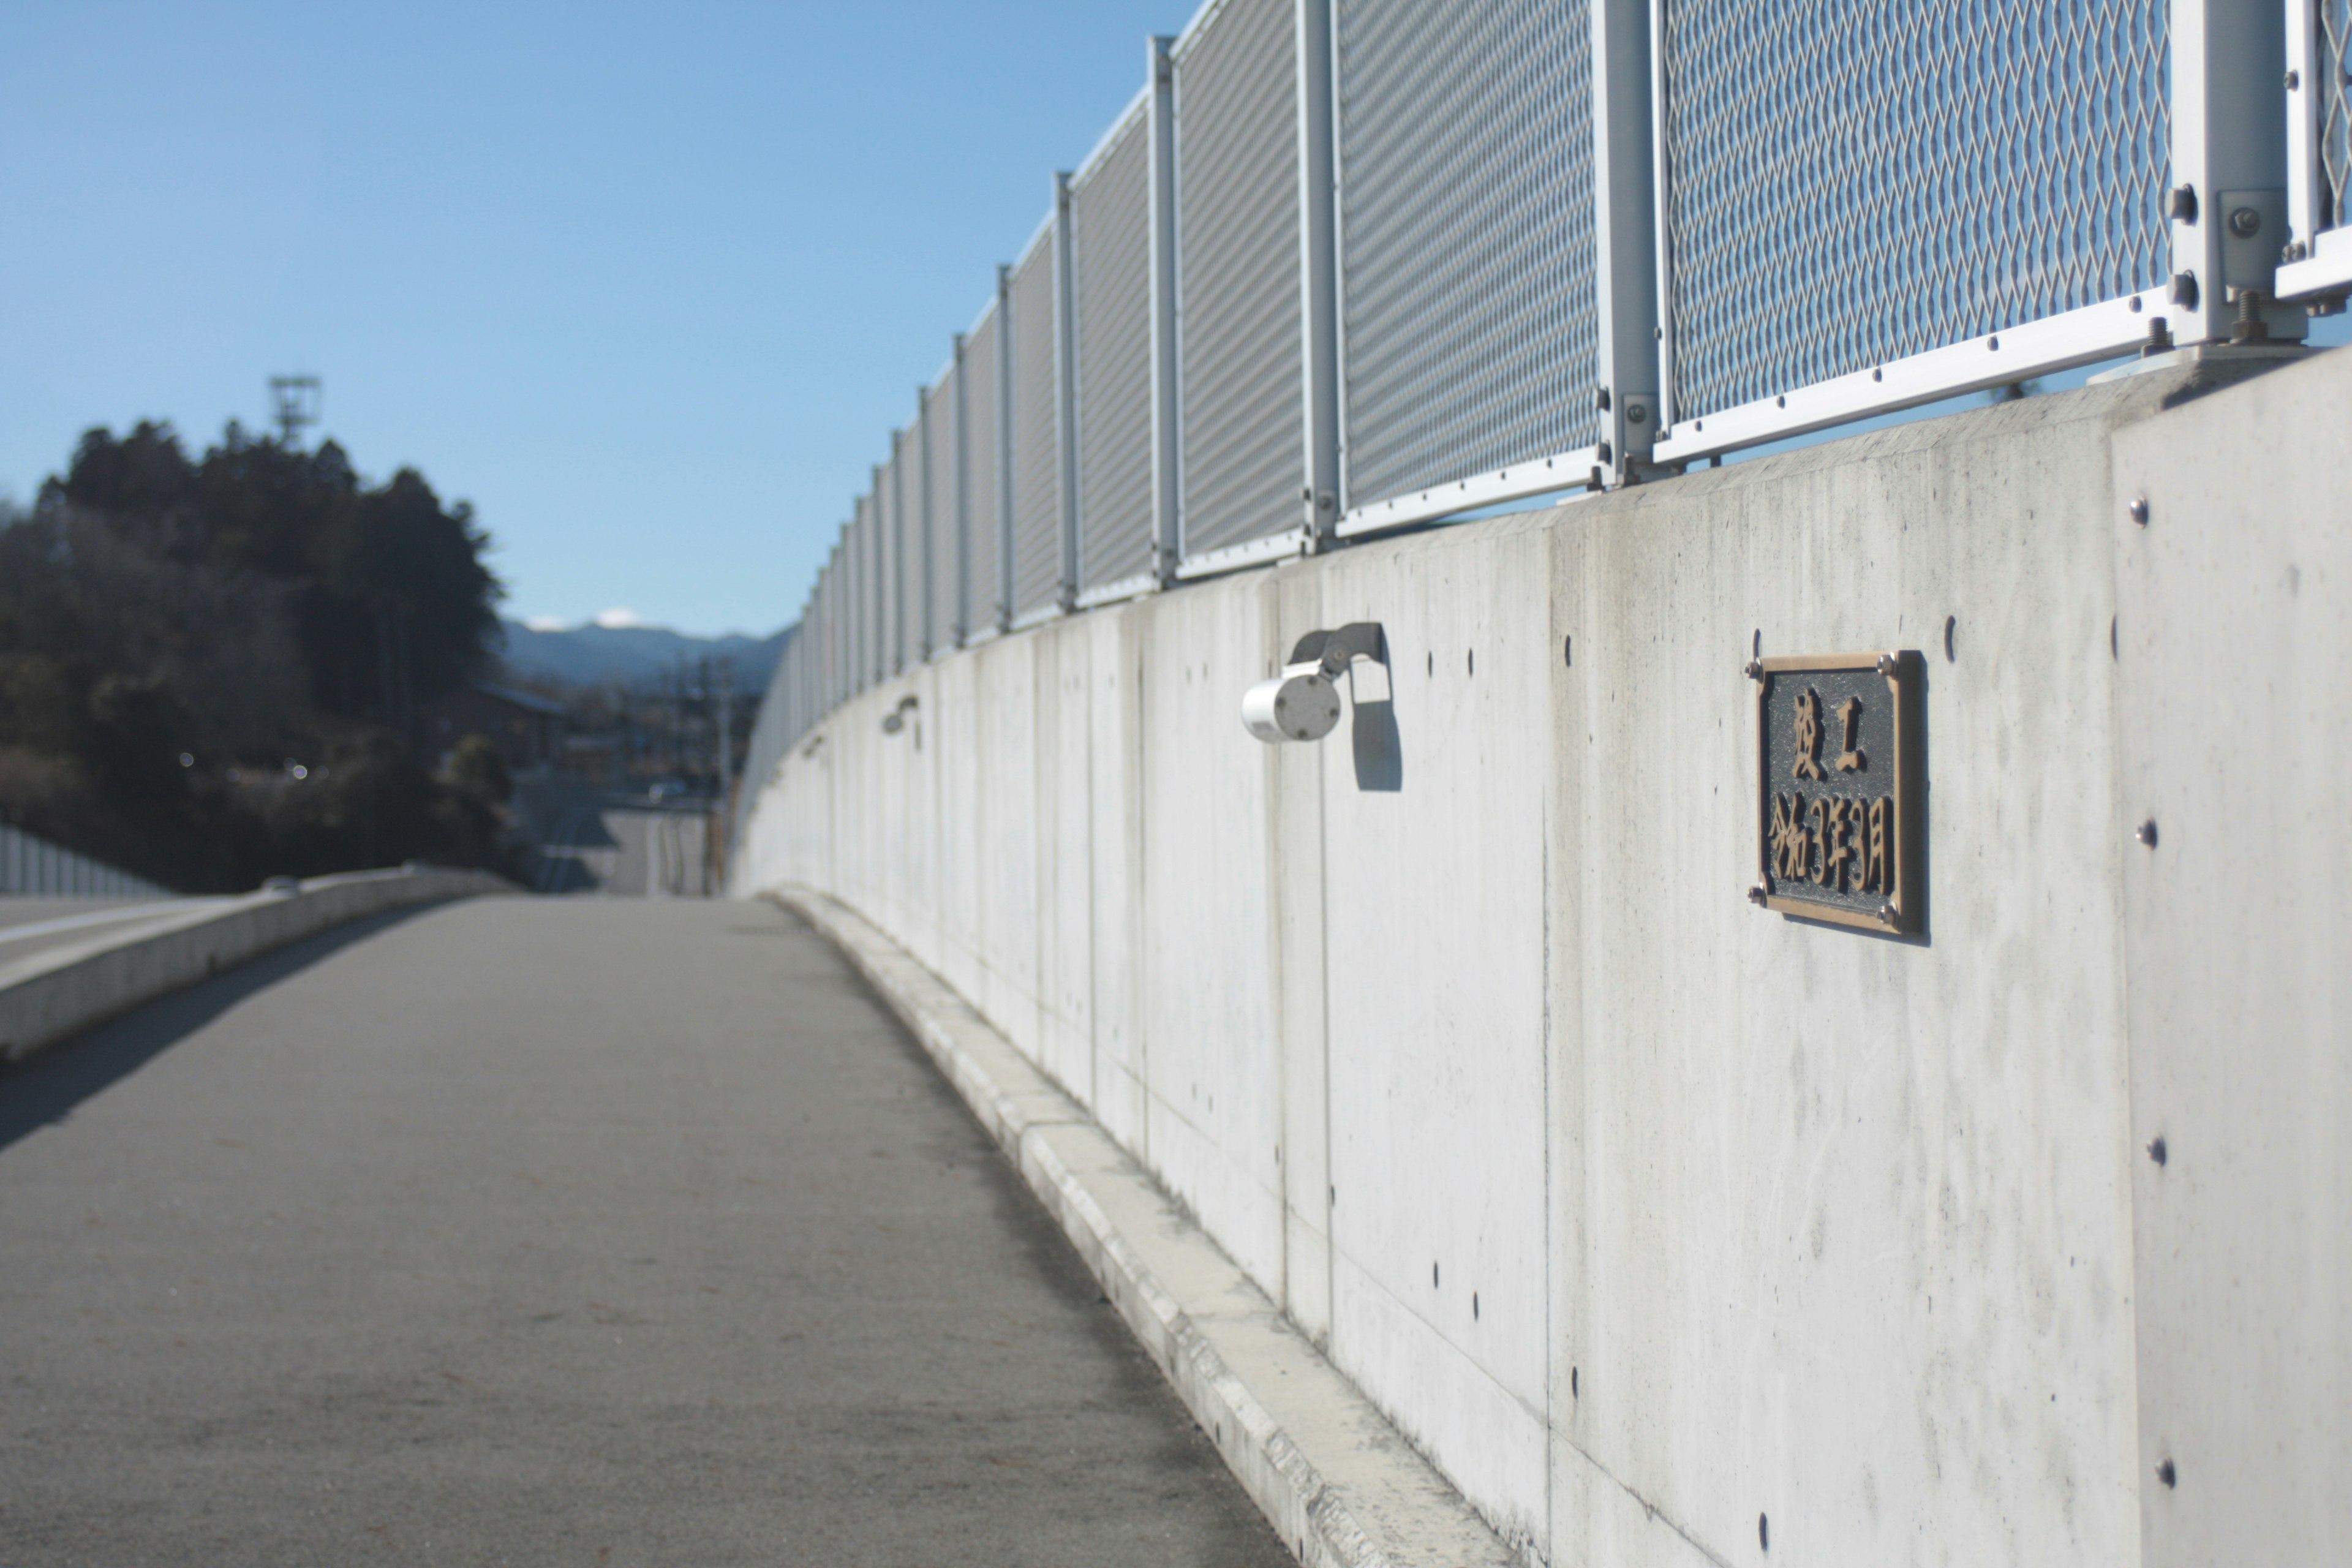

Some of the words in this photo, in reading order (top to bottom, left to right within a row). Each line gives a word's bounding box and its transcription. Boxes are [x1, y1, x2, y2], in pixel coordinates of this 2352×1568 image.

[1792, 687, 1858, 780] 竣工
[1768, 791, 1885, 895] 令和3年3月
